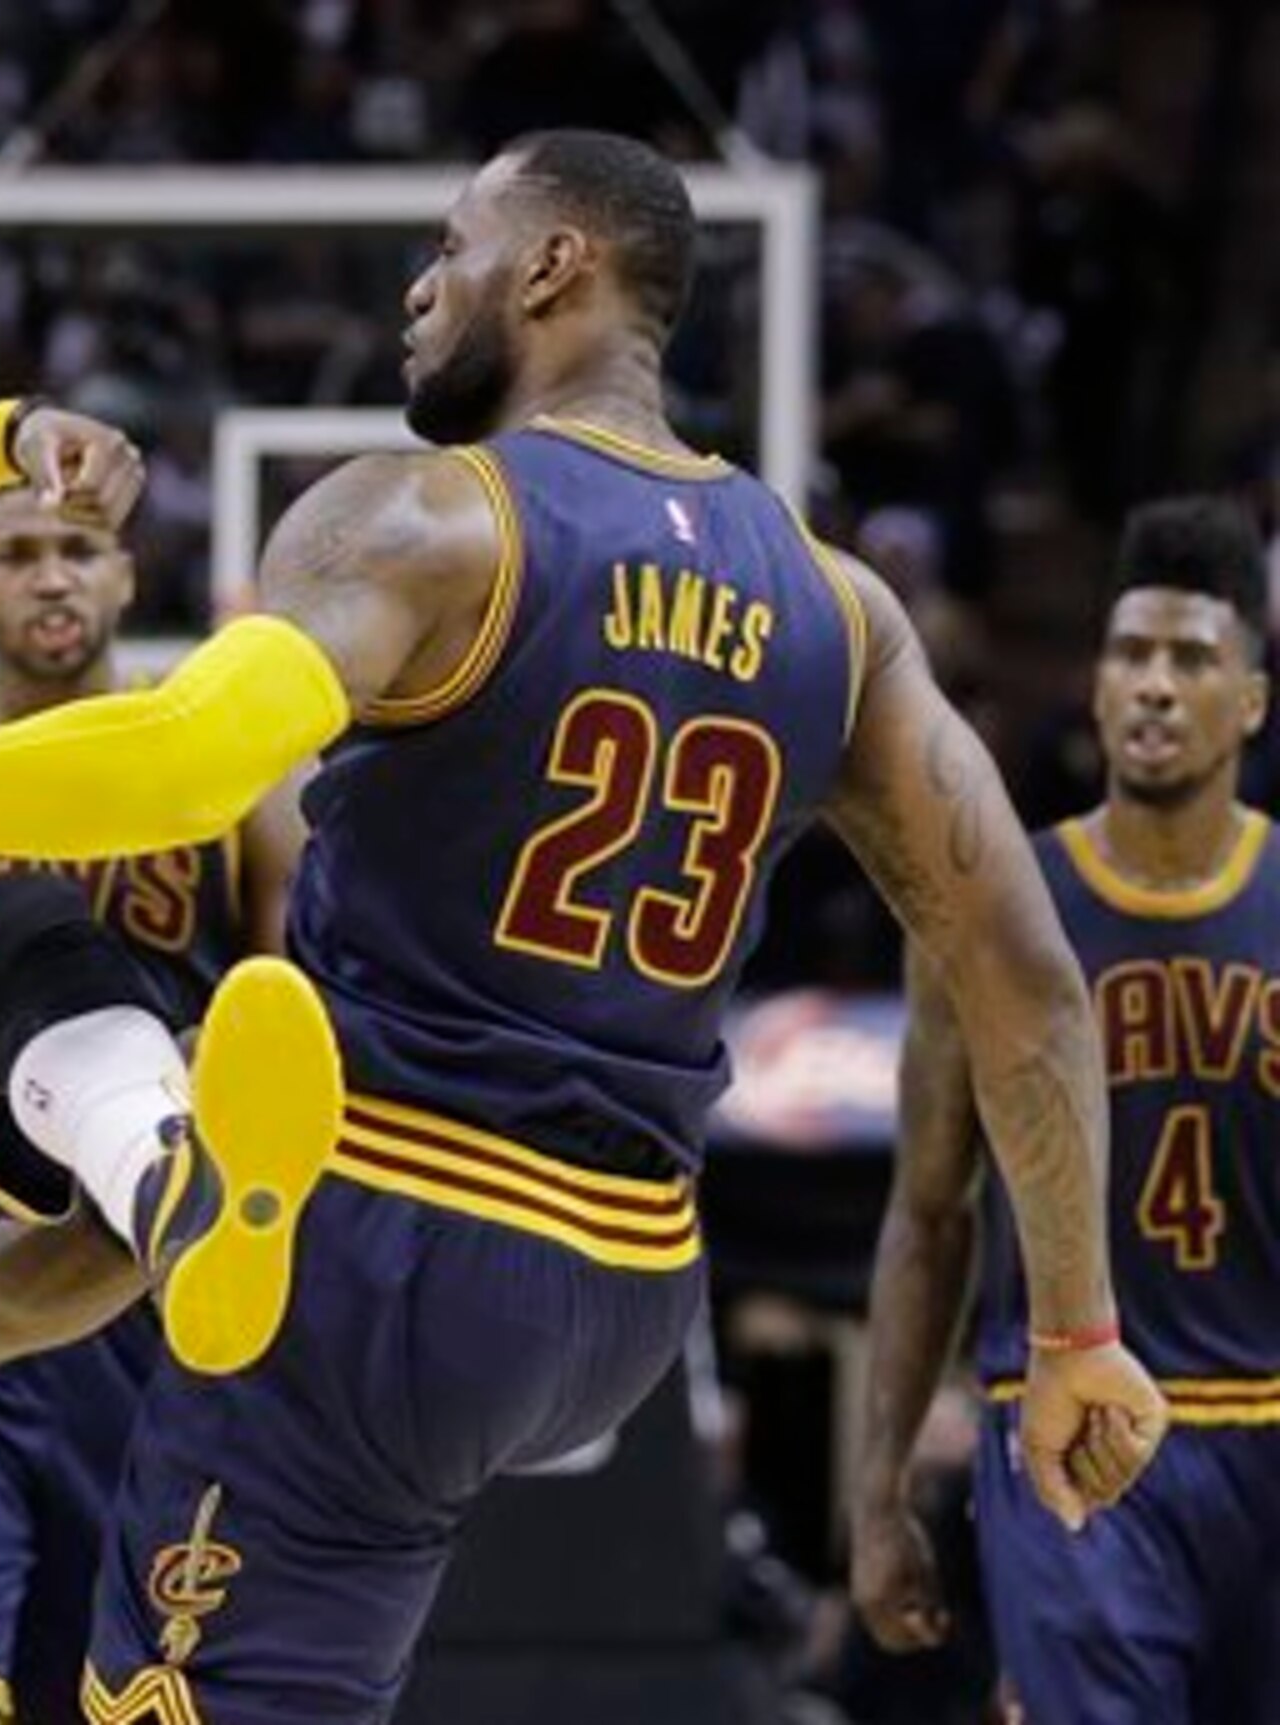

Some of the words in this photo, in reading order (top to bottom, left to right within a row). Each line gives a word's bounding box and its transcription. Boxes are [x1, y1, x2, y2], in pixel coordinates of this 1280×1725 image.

[605, 565, 772, 681] JAMES
[494, 689, 781, 986] 23
[1138, 1107, 1224, 1268] 4
